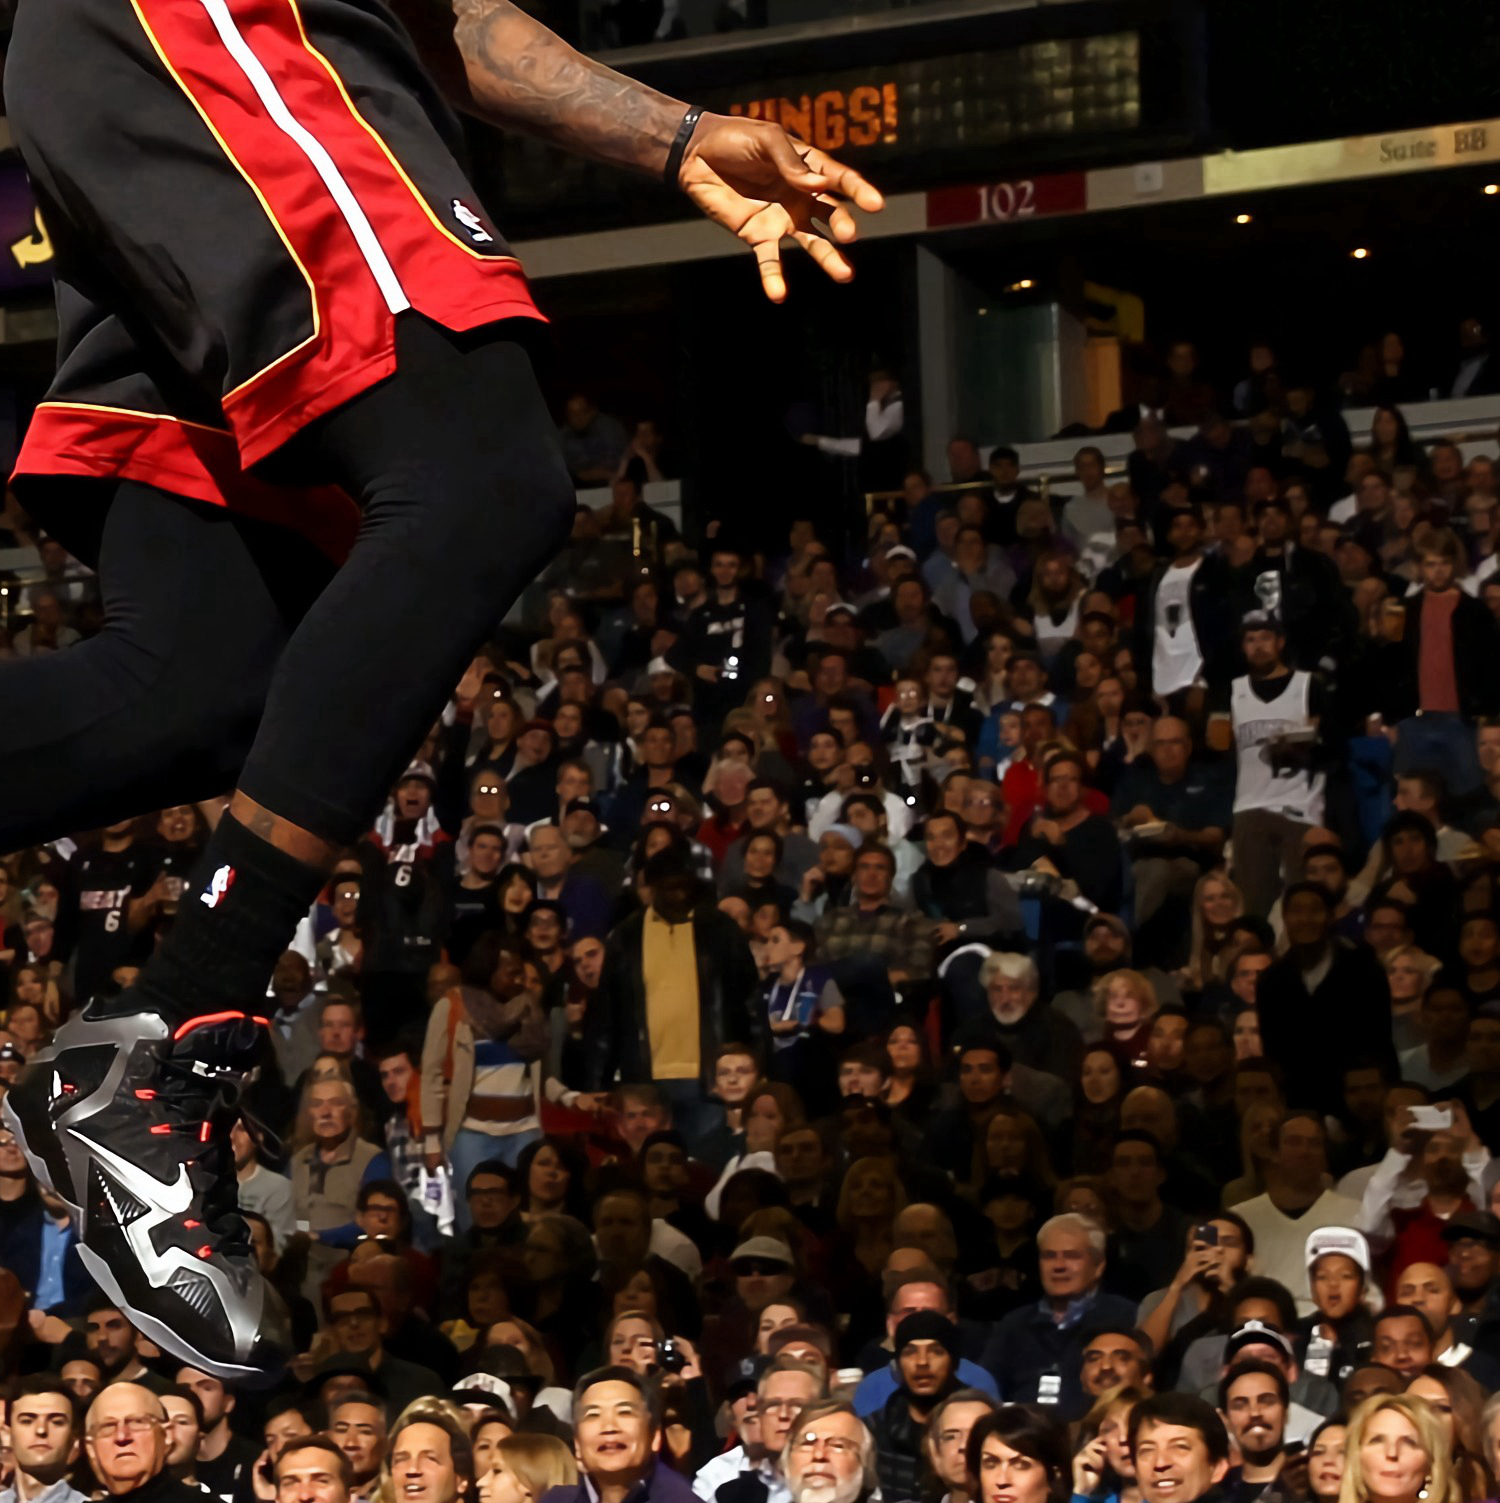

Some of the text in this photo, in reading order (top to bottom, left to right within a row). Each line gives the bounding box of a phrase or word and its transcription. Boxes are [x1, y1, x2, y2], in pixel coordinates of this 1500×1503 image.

[729, 82, 898, 151] NGS!
[977, 180, 1037, 223] 102
[104, 910, 121, 933] 6
